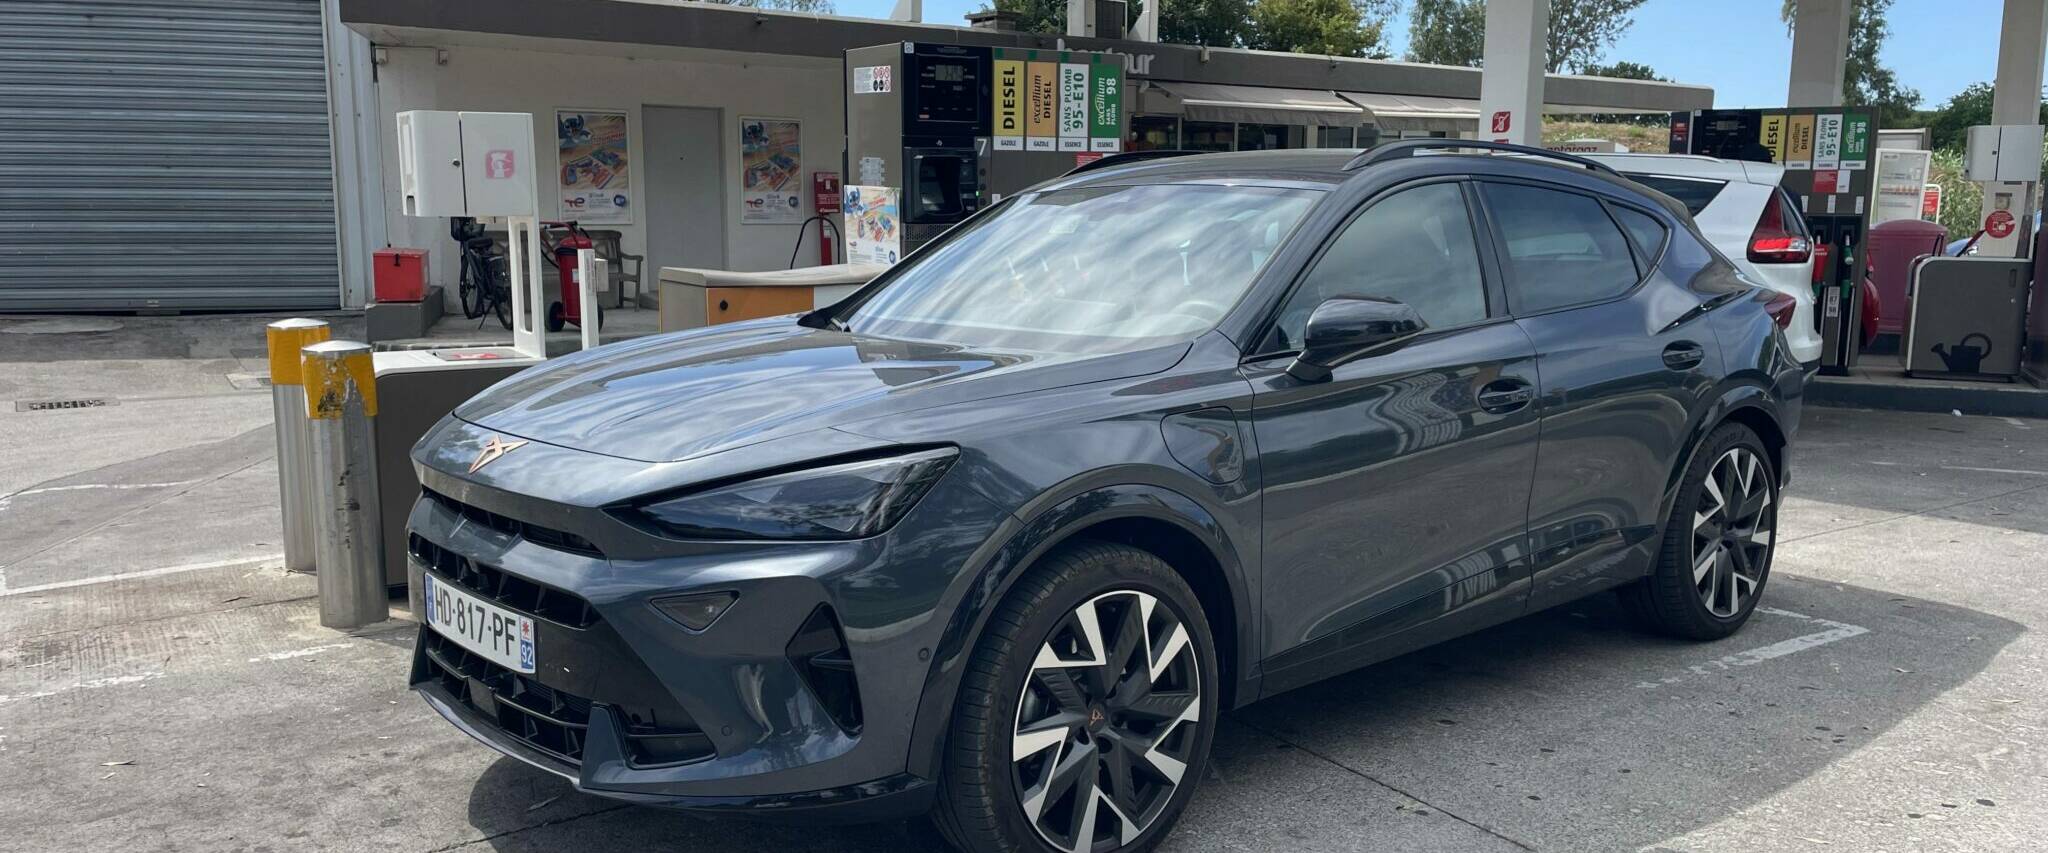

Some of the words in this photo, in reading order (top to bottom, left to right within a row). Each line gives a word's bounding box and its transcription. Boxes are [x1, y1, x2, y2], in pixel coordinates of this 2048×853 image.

[1003, 66, 1015, 129] DIESEL
[1033, 75, 1041, 124] excellium
[1043, 81, 1051, 119] DIESEL
[1064, 68, 1072, 104] PLOMB
[1073, 73, 1084, 129] 95-E10
[1095, 77, 1105, 125] excellium
[1107, 78, 1116, 95] 98
[1064, 107, 1072, 132] SANS
[1801, 126, 1810, 150] DIESEL
[1826, 120, 1838, 156] 95-E10
[977, 138, 987, 156] 7
[434, 584, 516, 656] HD-817-PF
[521, 643, 533, 665] 92
